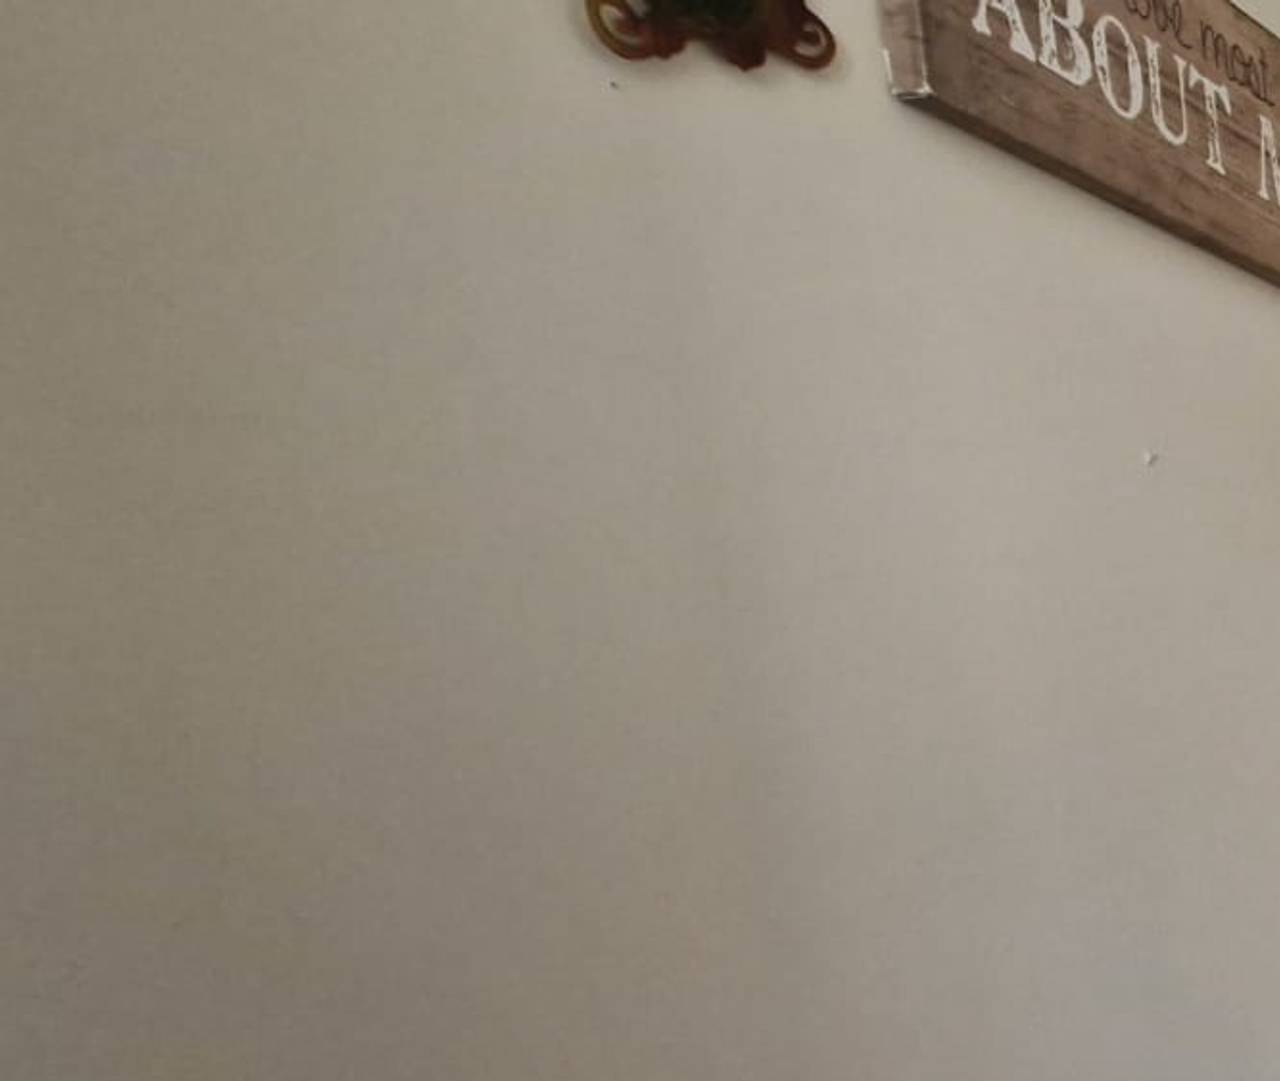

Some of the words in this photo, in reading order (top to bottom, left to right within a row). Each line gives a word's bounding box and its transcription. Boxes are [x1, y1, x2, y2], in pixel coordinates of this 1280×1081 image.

[971, 0, 1232, 175] ABOUT
[1123, 0, 1193, 49] ove
[1200, 19, 1275, 107] most
